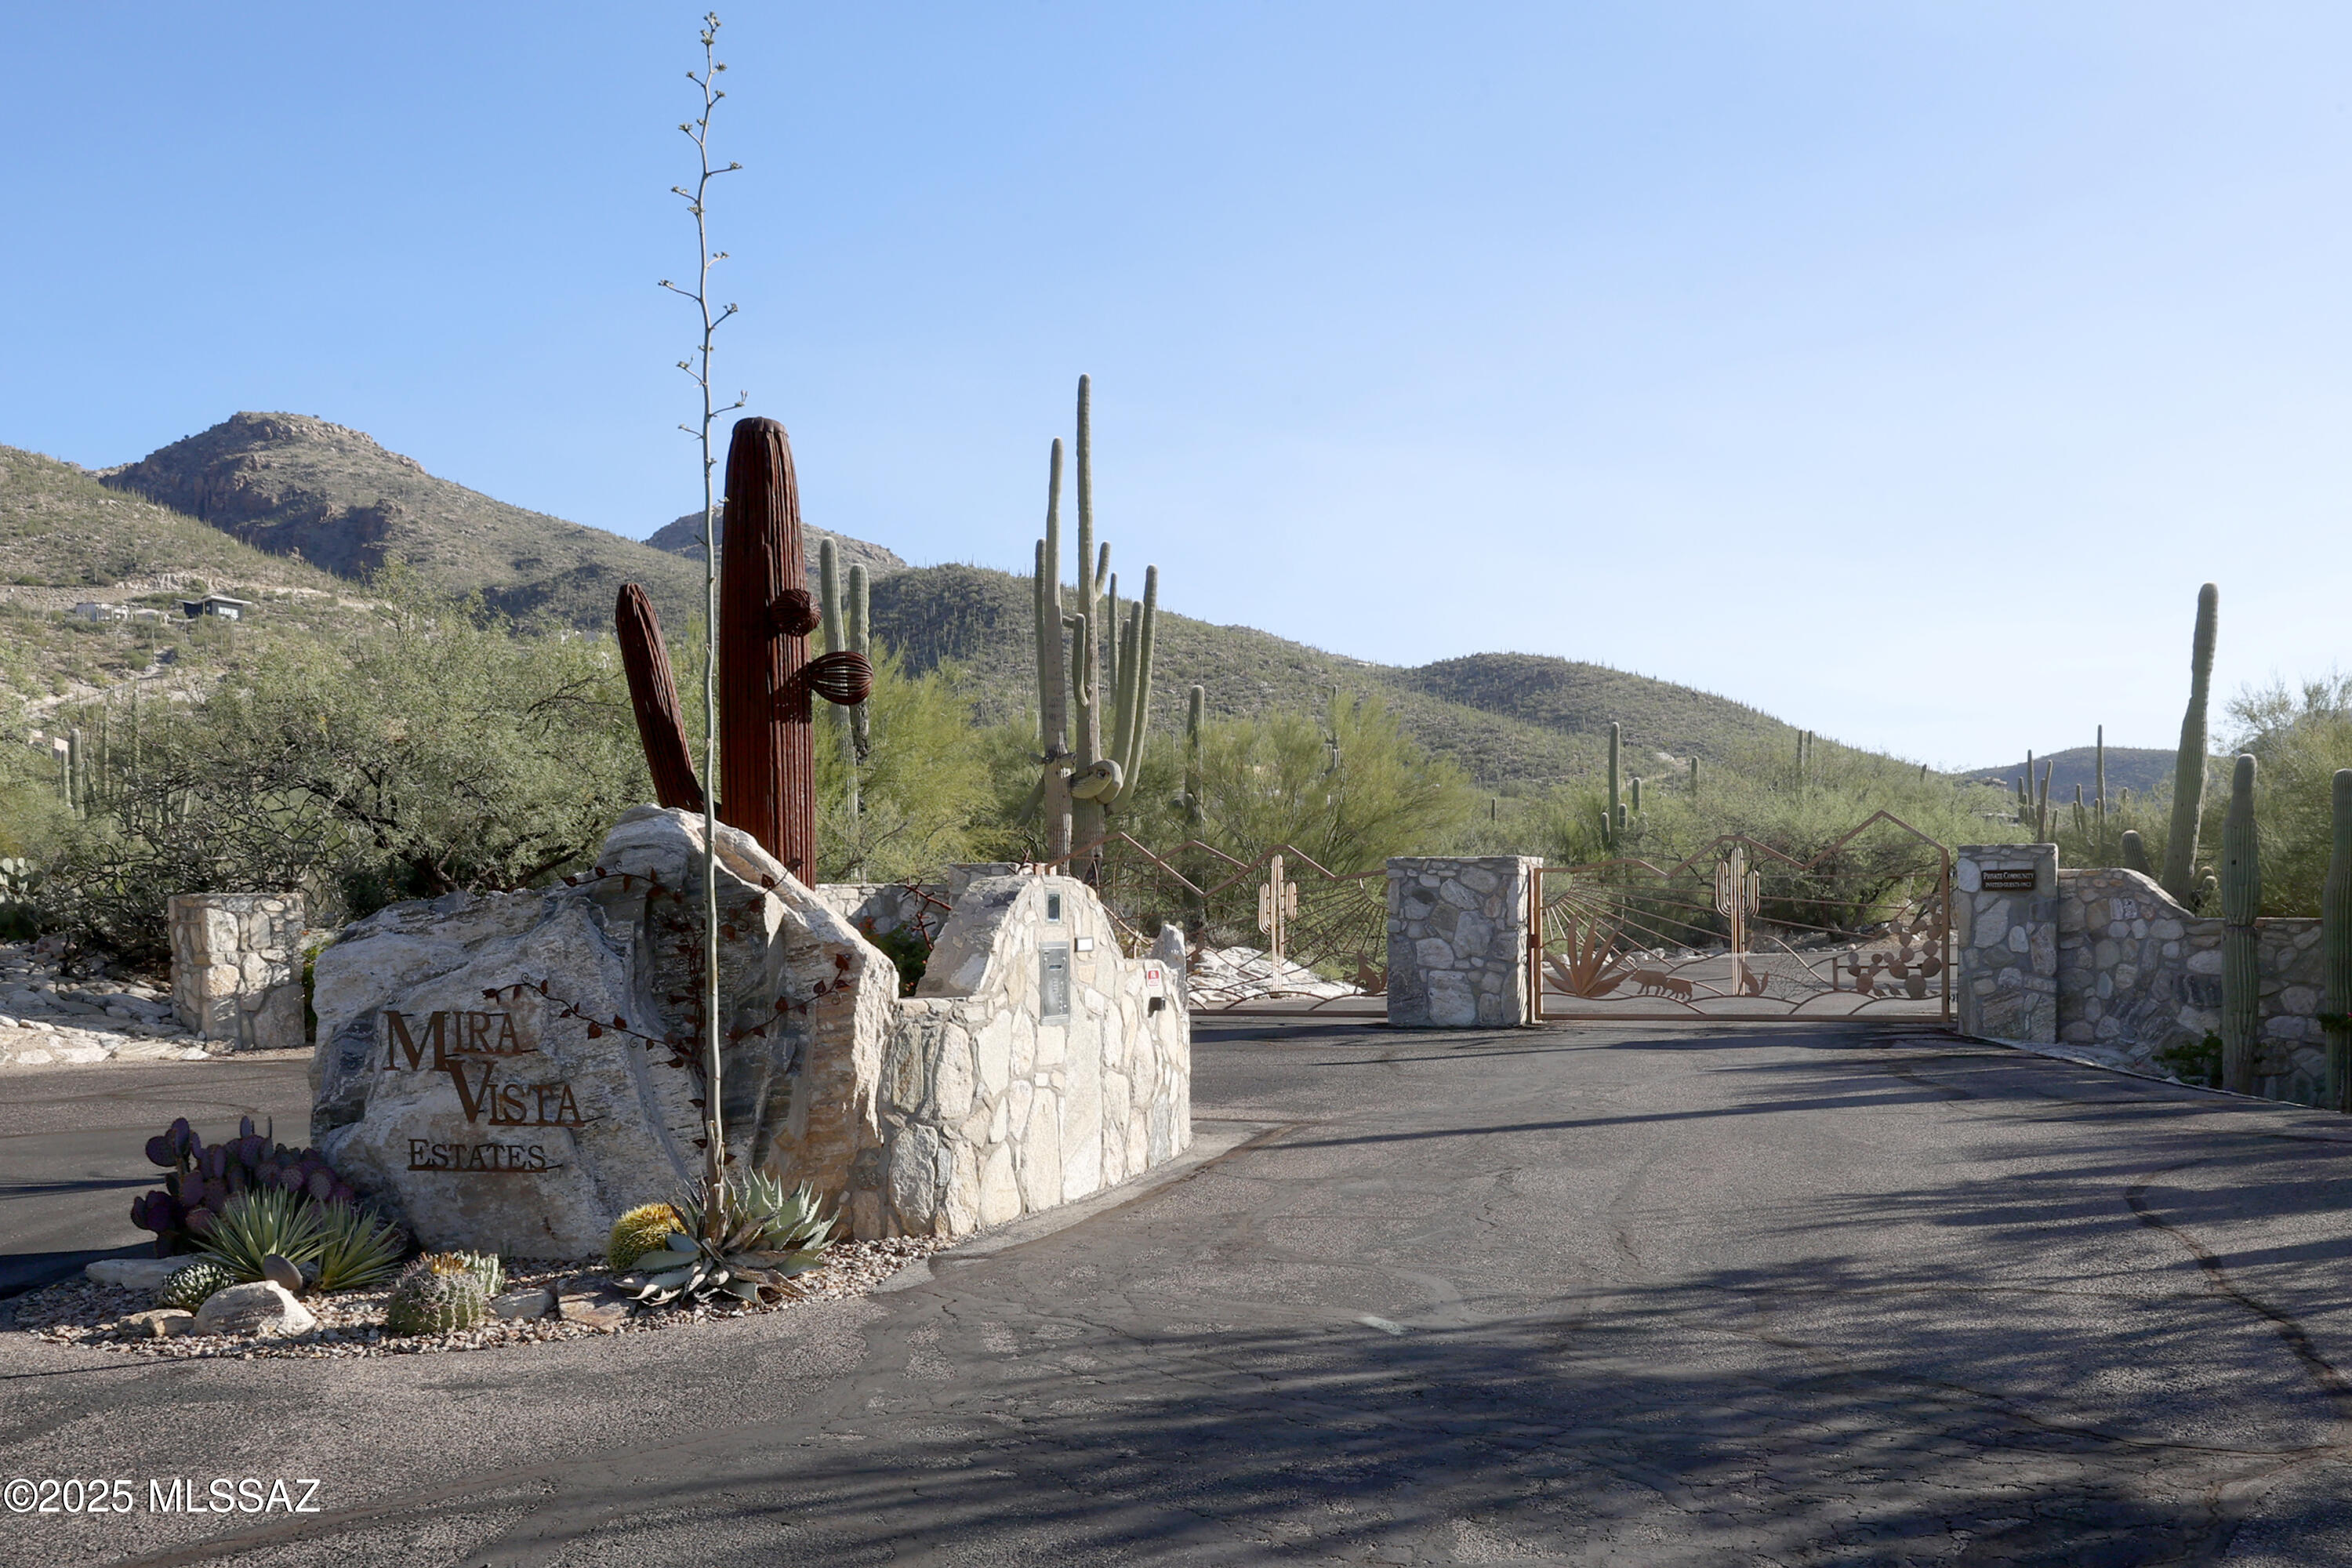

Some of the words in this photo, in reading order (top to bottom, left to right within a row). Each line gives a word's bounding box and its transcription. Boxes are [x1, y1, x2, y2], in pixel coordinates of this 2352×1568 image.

[383, 1010, 523, 1072] MIRA
[446, 1059, 585, 1127] VISTA
[407, 1138, 547, 1172] ESTATES
